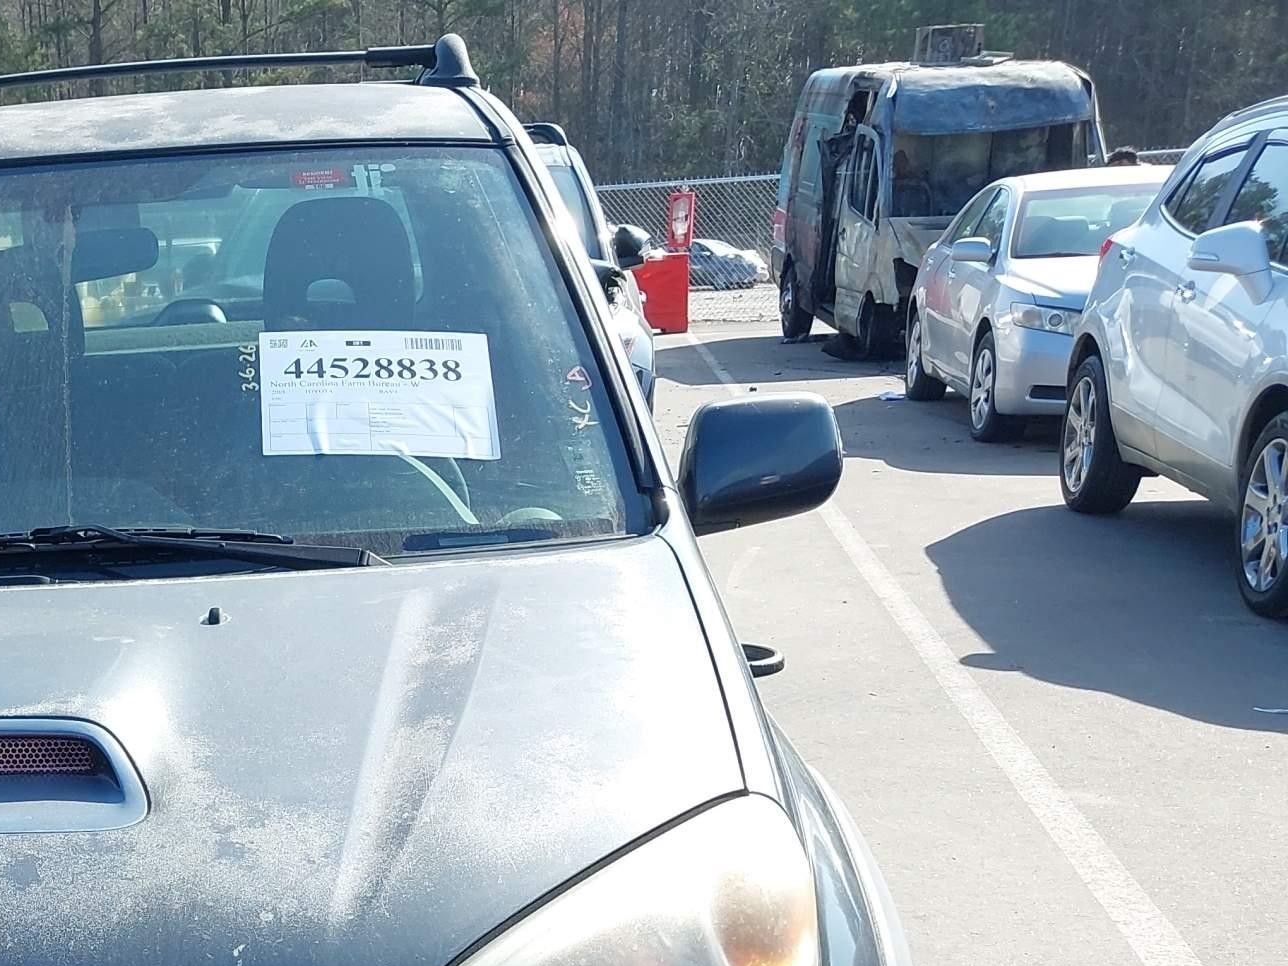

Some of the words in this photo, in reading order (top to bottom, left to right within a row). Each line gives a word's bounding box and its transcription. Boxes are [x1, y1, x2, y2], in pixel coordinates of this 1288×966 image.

[283, 357, 462, 382] 44528838
[270, 379, 297, 388] North
[299, 380, 339, 388] Carolina
[341, 379, 365, 388] Farm
[368, 380, 401, 388] Bureau
